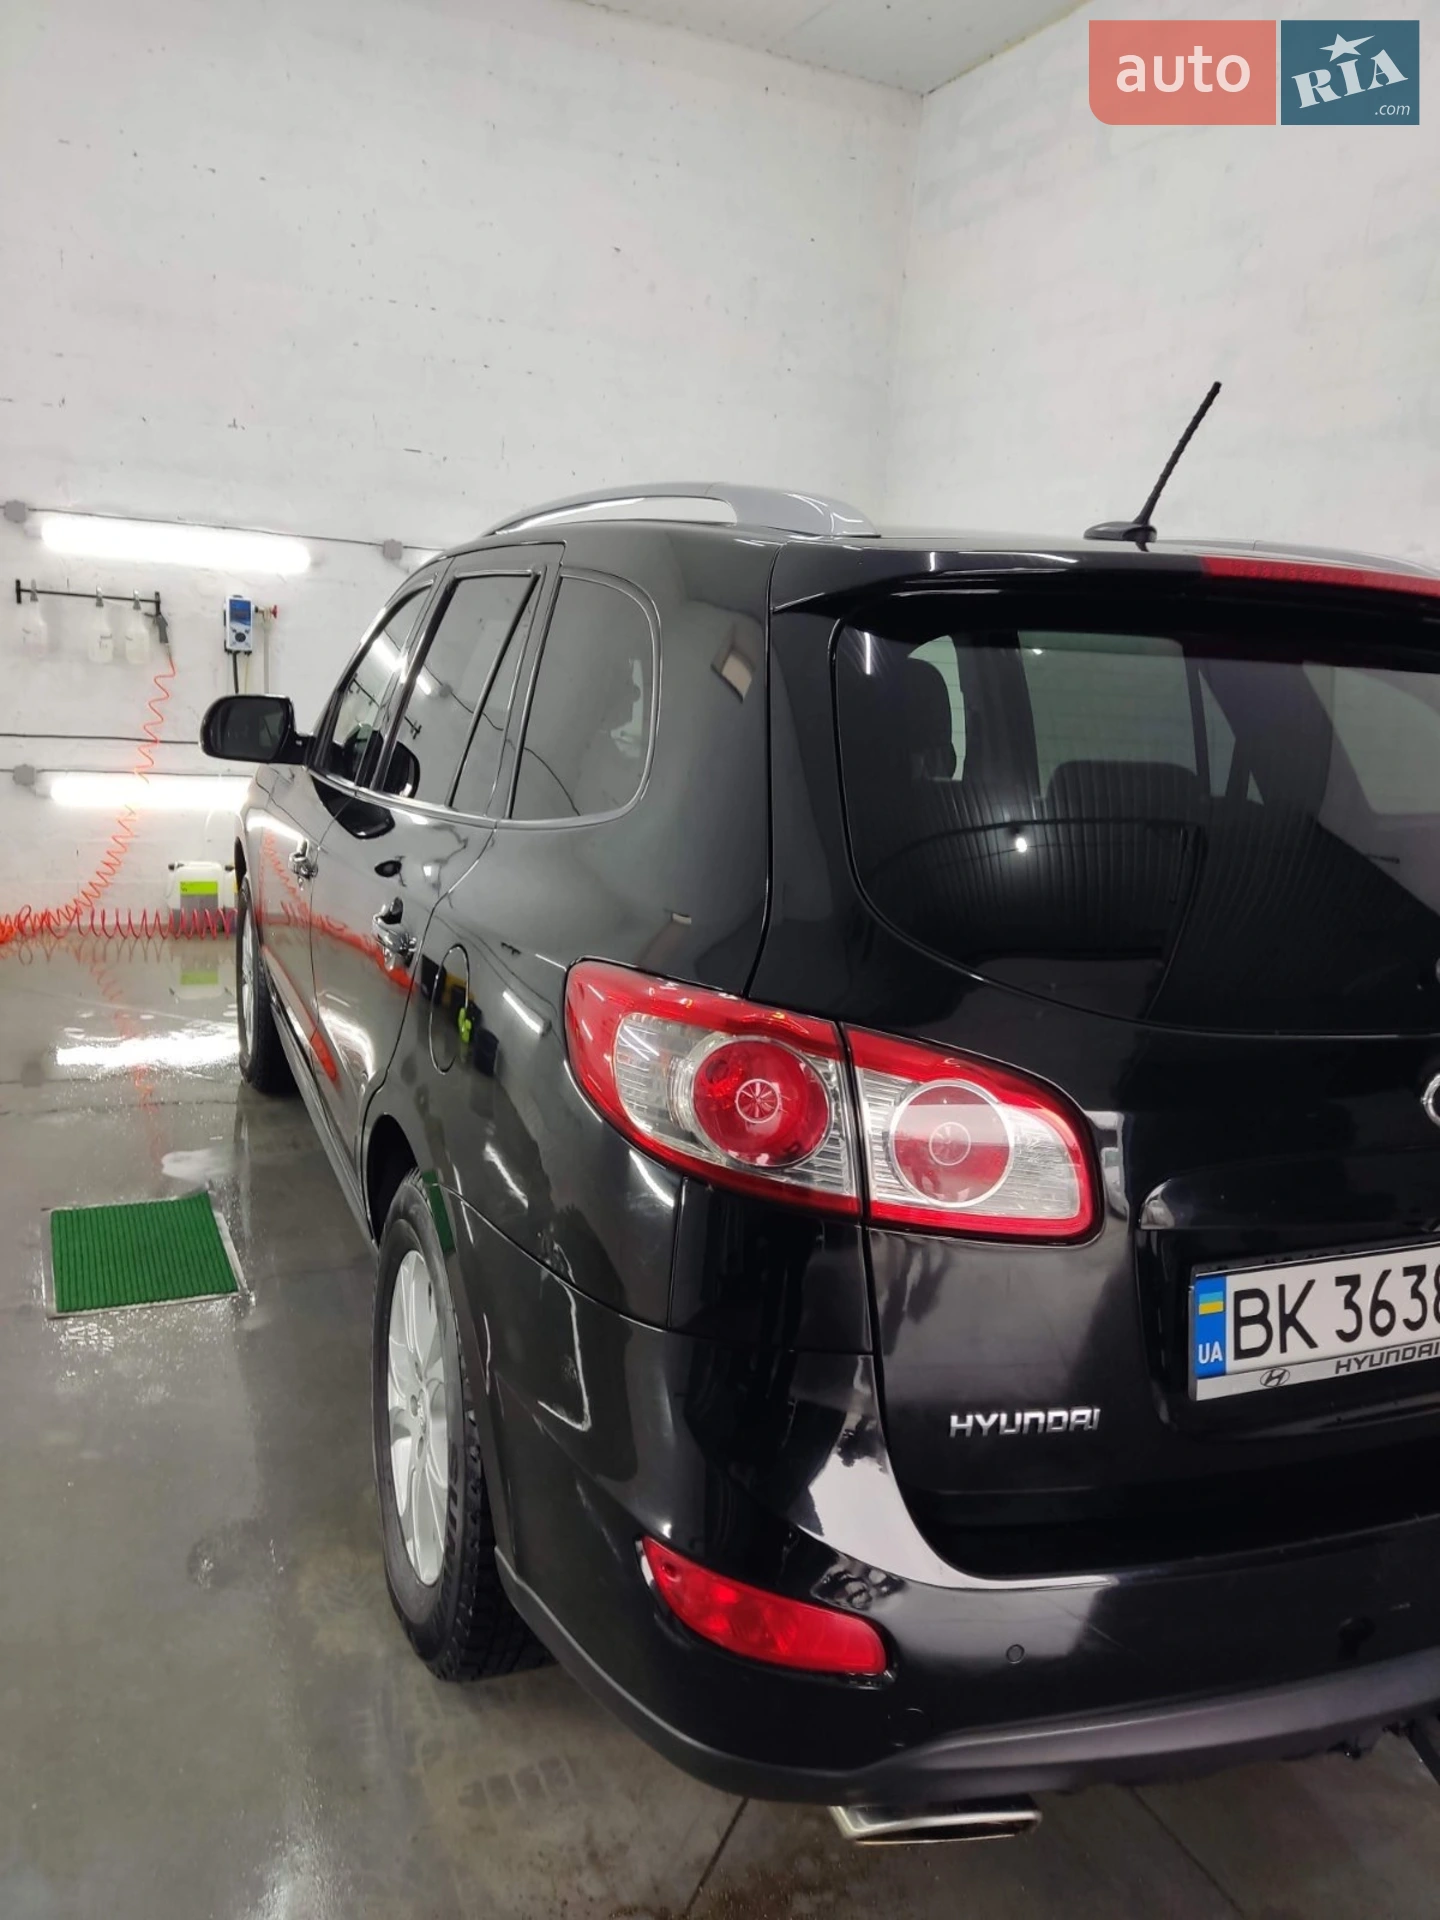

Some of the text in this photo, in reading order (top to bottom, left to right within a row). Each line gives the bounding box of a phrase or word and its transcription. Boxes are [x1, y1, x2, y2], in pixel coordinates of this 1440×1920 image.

[1233, 1263, 1440, 1361] BK 363
[1198, 1341, 1223, 1364] UA
[1334, 1341, 1440, 1375] HYUNDAI
[949, 1408, 1101, 1438] HYUNDAI
